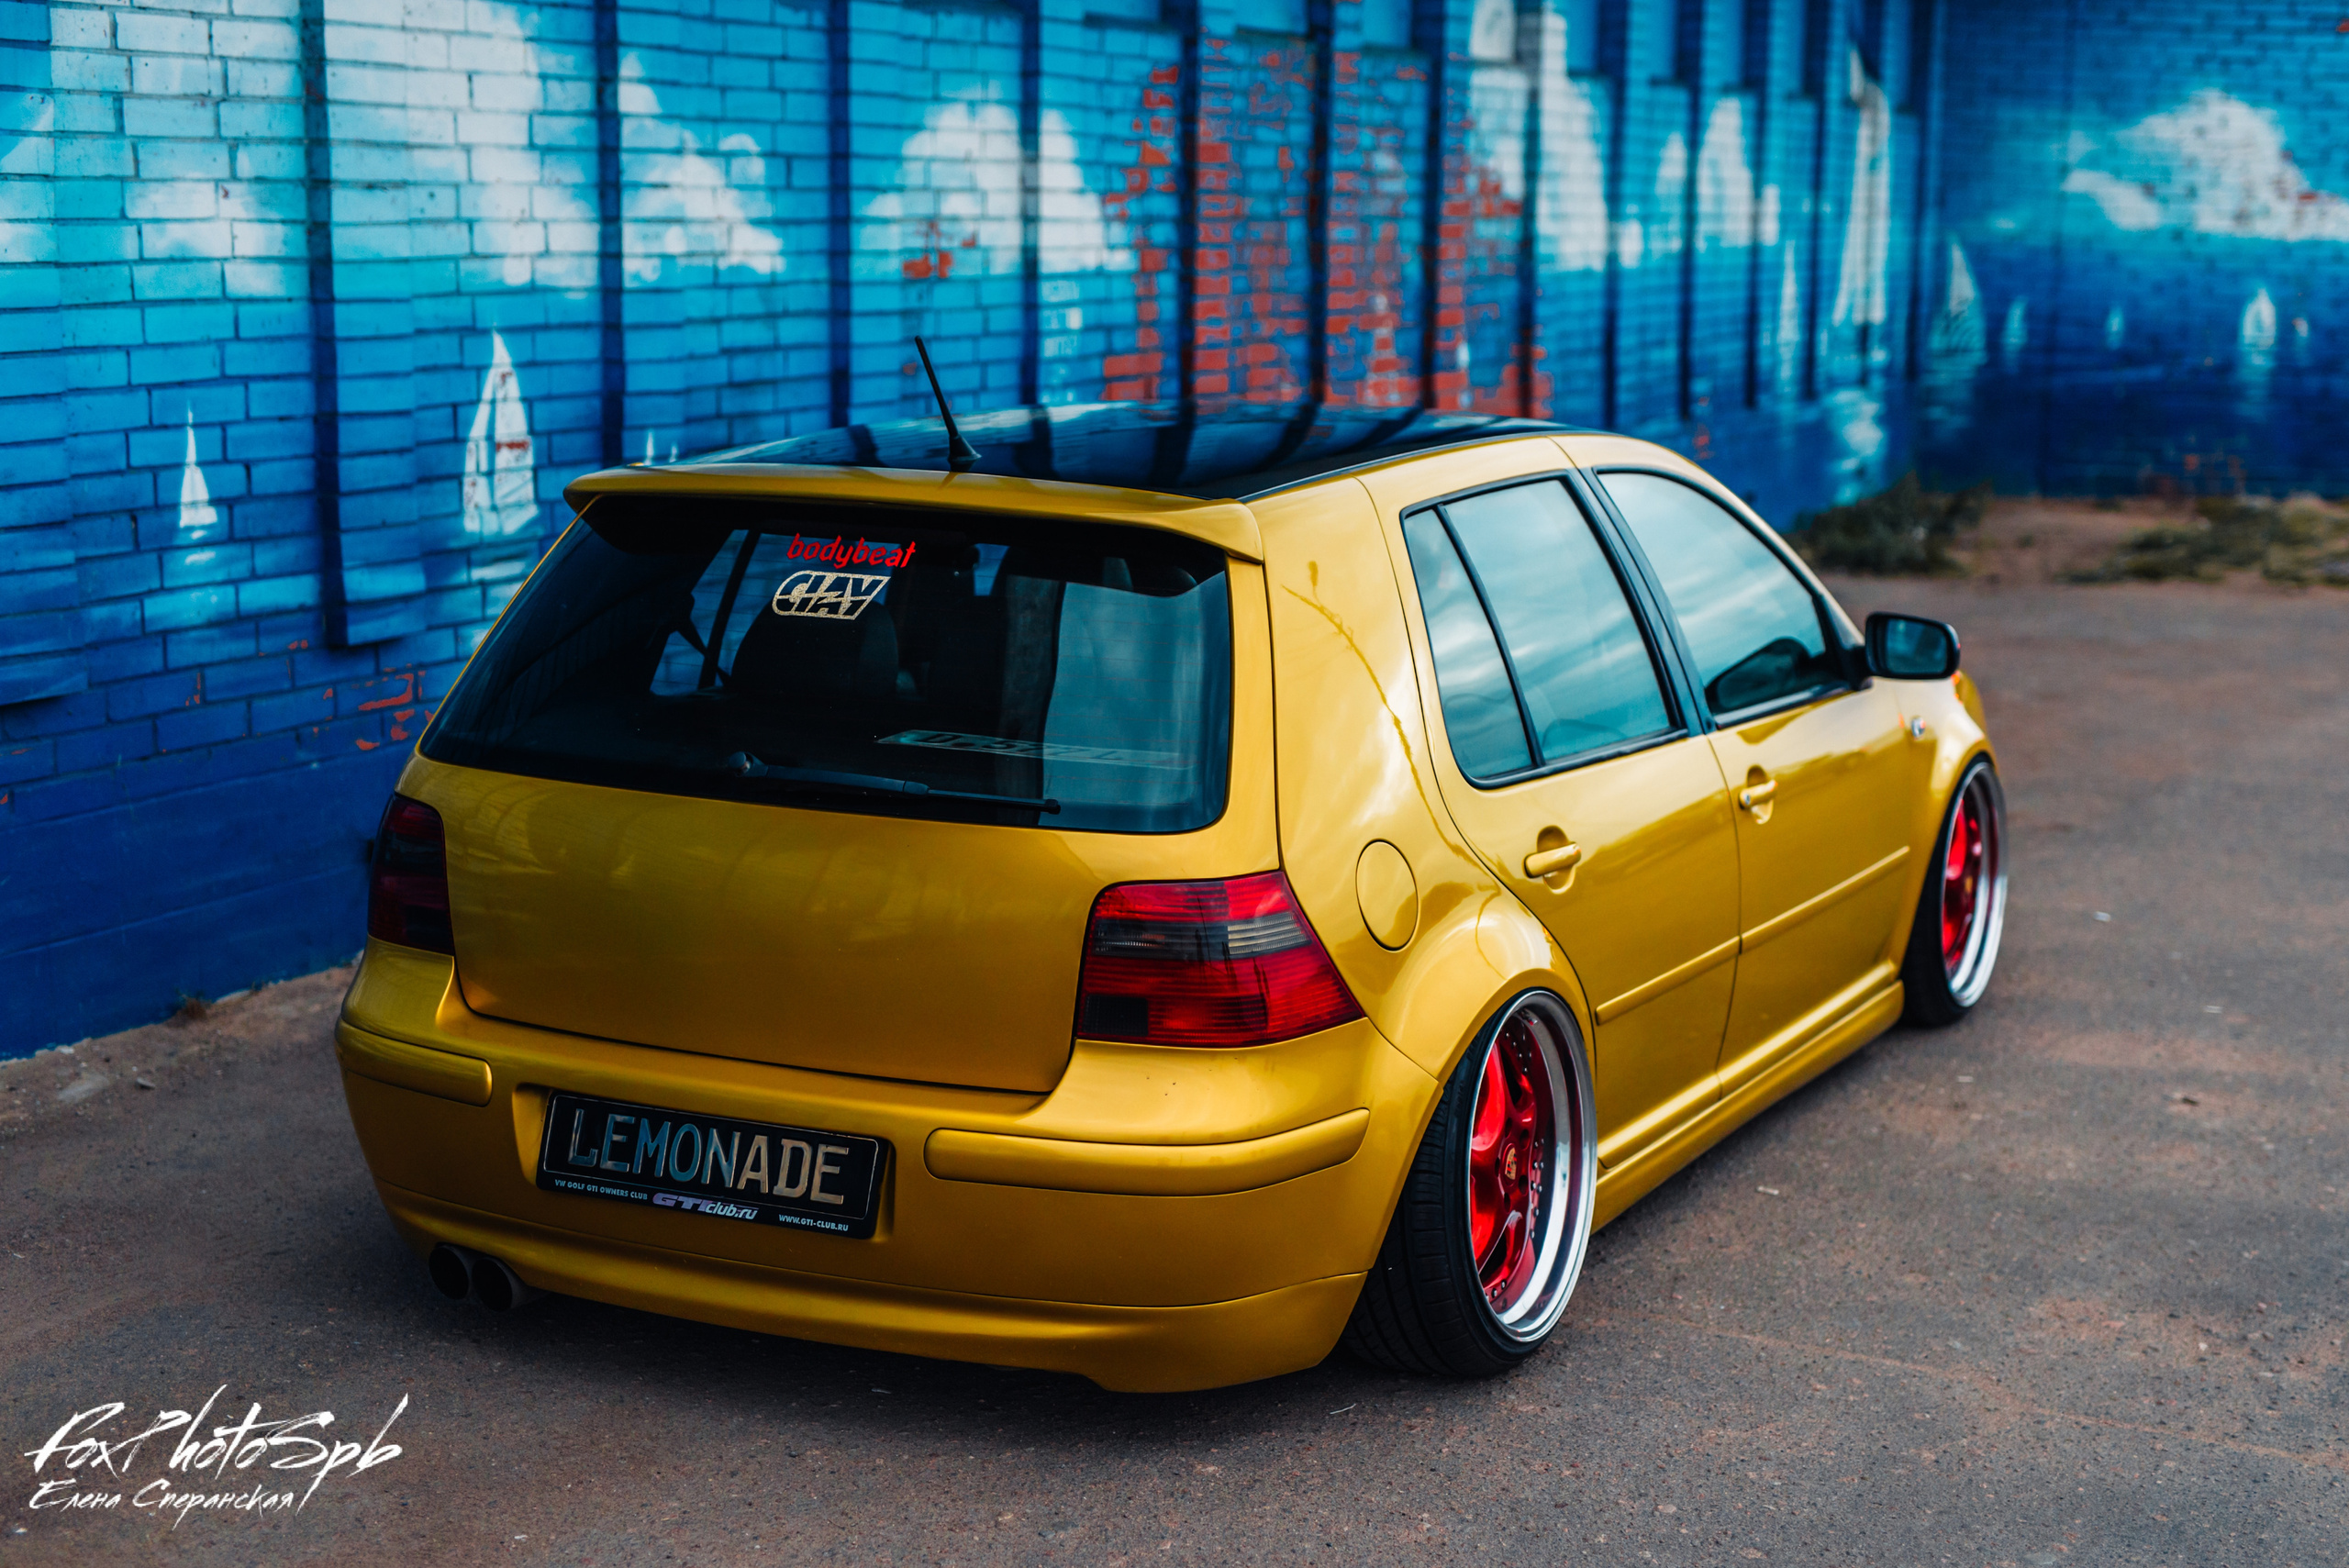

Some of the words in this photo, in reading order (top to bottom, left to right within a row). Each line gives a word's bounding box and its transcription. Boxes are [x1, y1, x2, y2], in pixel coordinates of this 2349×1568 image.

[786, 532, 916, 569] bodybeat
[568, 1108, 849, 1205] LEMONADE
[554, 1179, 566, 1187] VW
[567, 1182, 585, 1190] GOLF
[586, 1184, 598, 1193] GTI
[599, 1186, 629, 1197] OWNERS
[629, 1191, 648, 1200] CLUB
[778, 1214, 849, 1232] WWW.GTI-CLUB.RU
